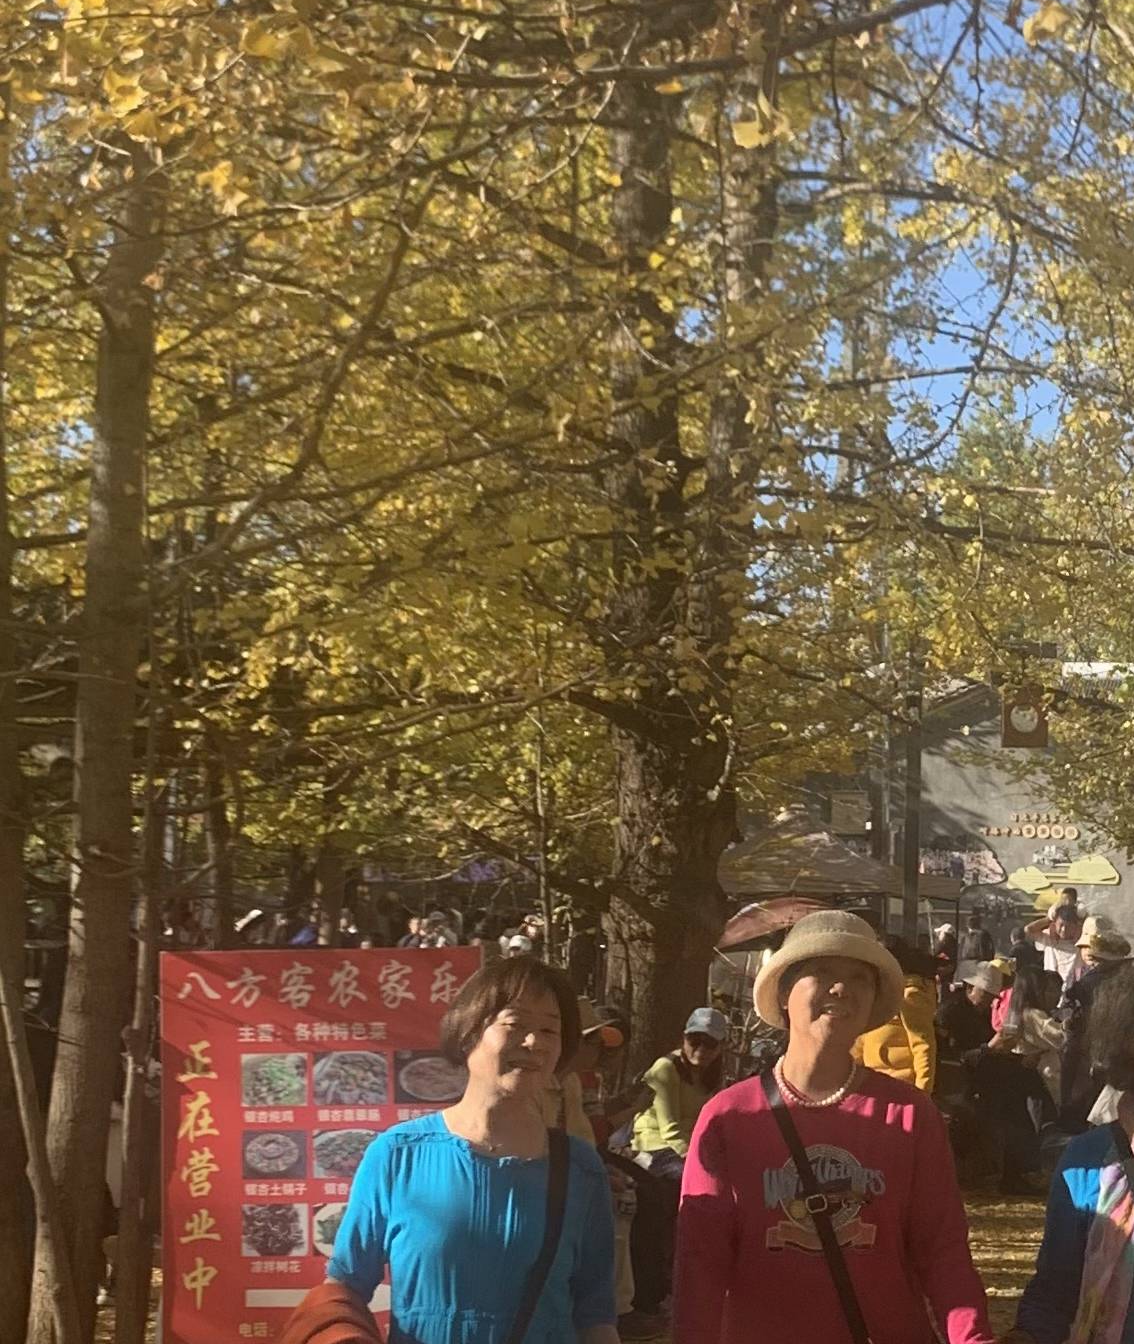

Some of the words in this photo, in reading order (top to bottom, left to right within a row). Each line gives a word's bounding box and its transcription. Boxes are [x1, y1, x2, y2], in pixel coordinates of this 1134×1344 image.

[176, 959, 464, 1009] 八方客农家乐
[175, 1040, 222, 1311] 正在营业中
